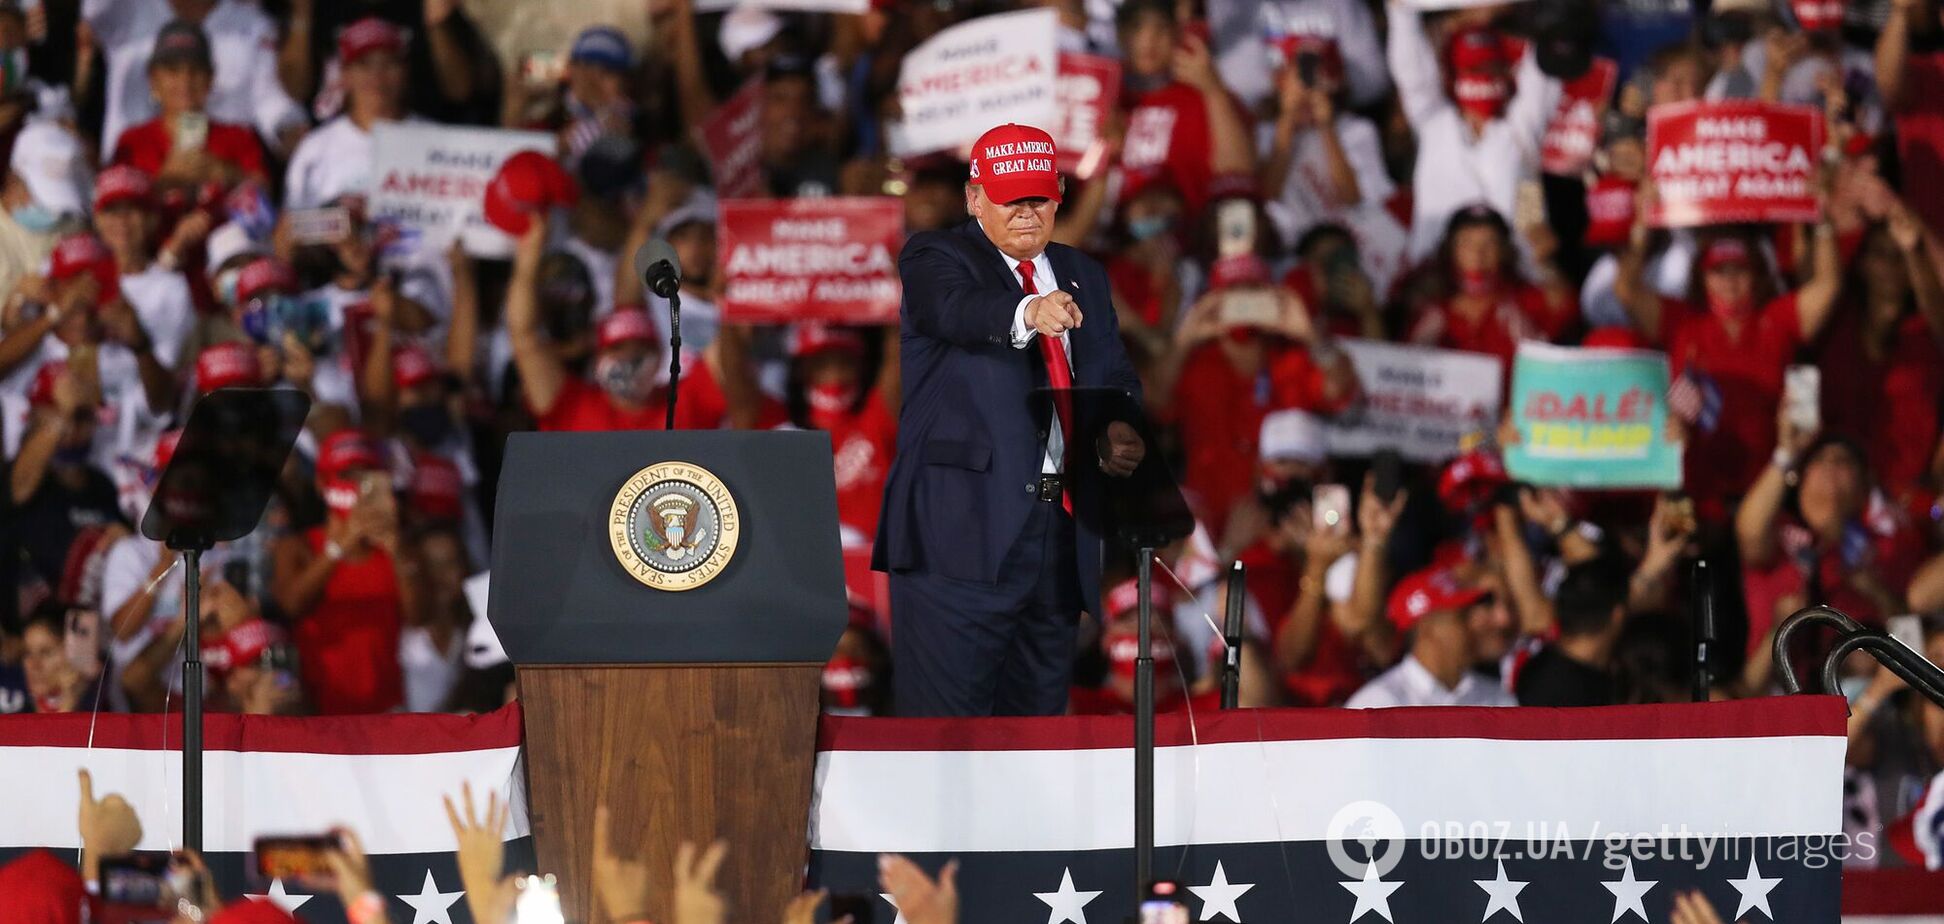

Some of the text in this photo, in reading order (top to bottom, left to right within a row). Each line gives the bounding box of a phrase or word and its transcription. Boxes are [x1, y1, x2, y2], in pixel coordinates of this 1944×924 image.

[1694, 117, 1768, 138] MAKE
[985, 141, 1055, 160] MAKE AMERICA
[1653, 141, 1811, 174] AMERICA
[992, 159, 1026, 175] GREAT
[771, 218, 846, 241] MAKE
[725, 242, 893, 277] AMERICA
[729, 278, 898, 303] GREAT AGAIN
[1531, 423, 1652, 450] TRUMP
[615, 466, 735, 585] SEAL OF THE PRESIDENT OF THE UNITED STATES
